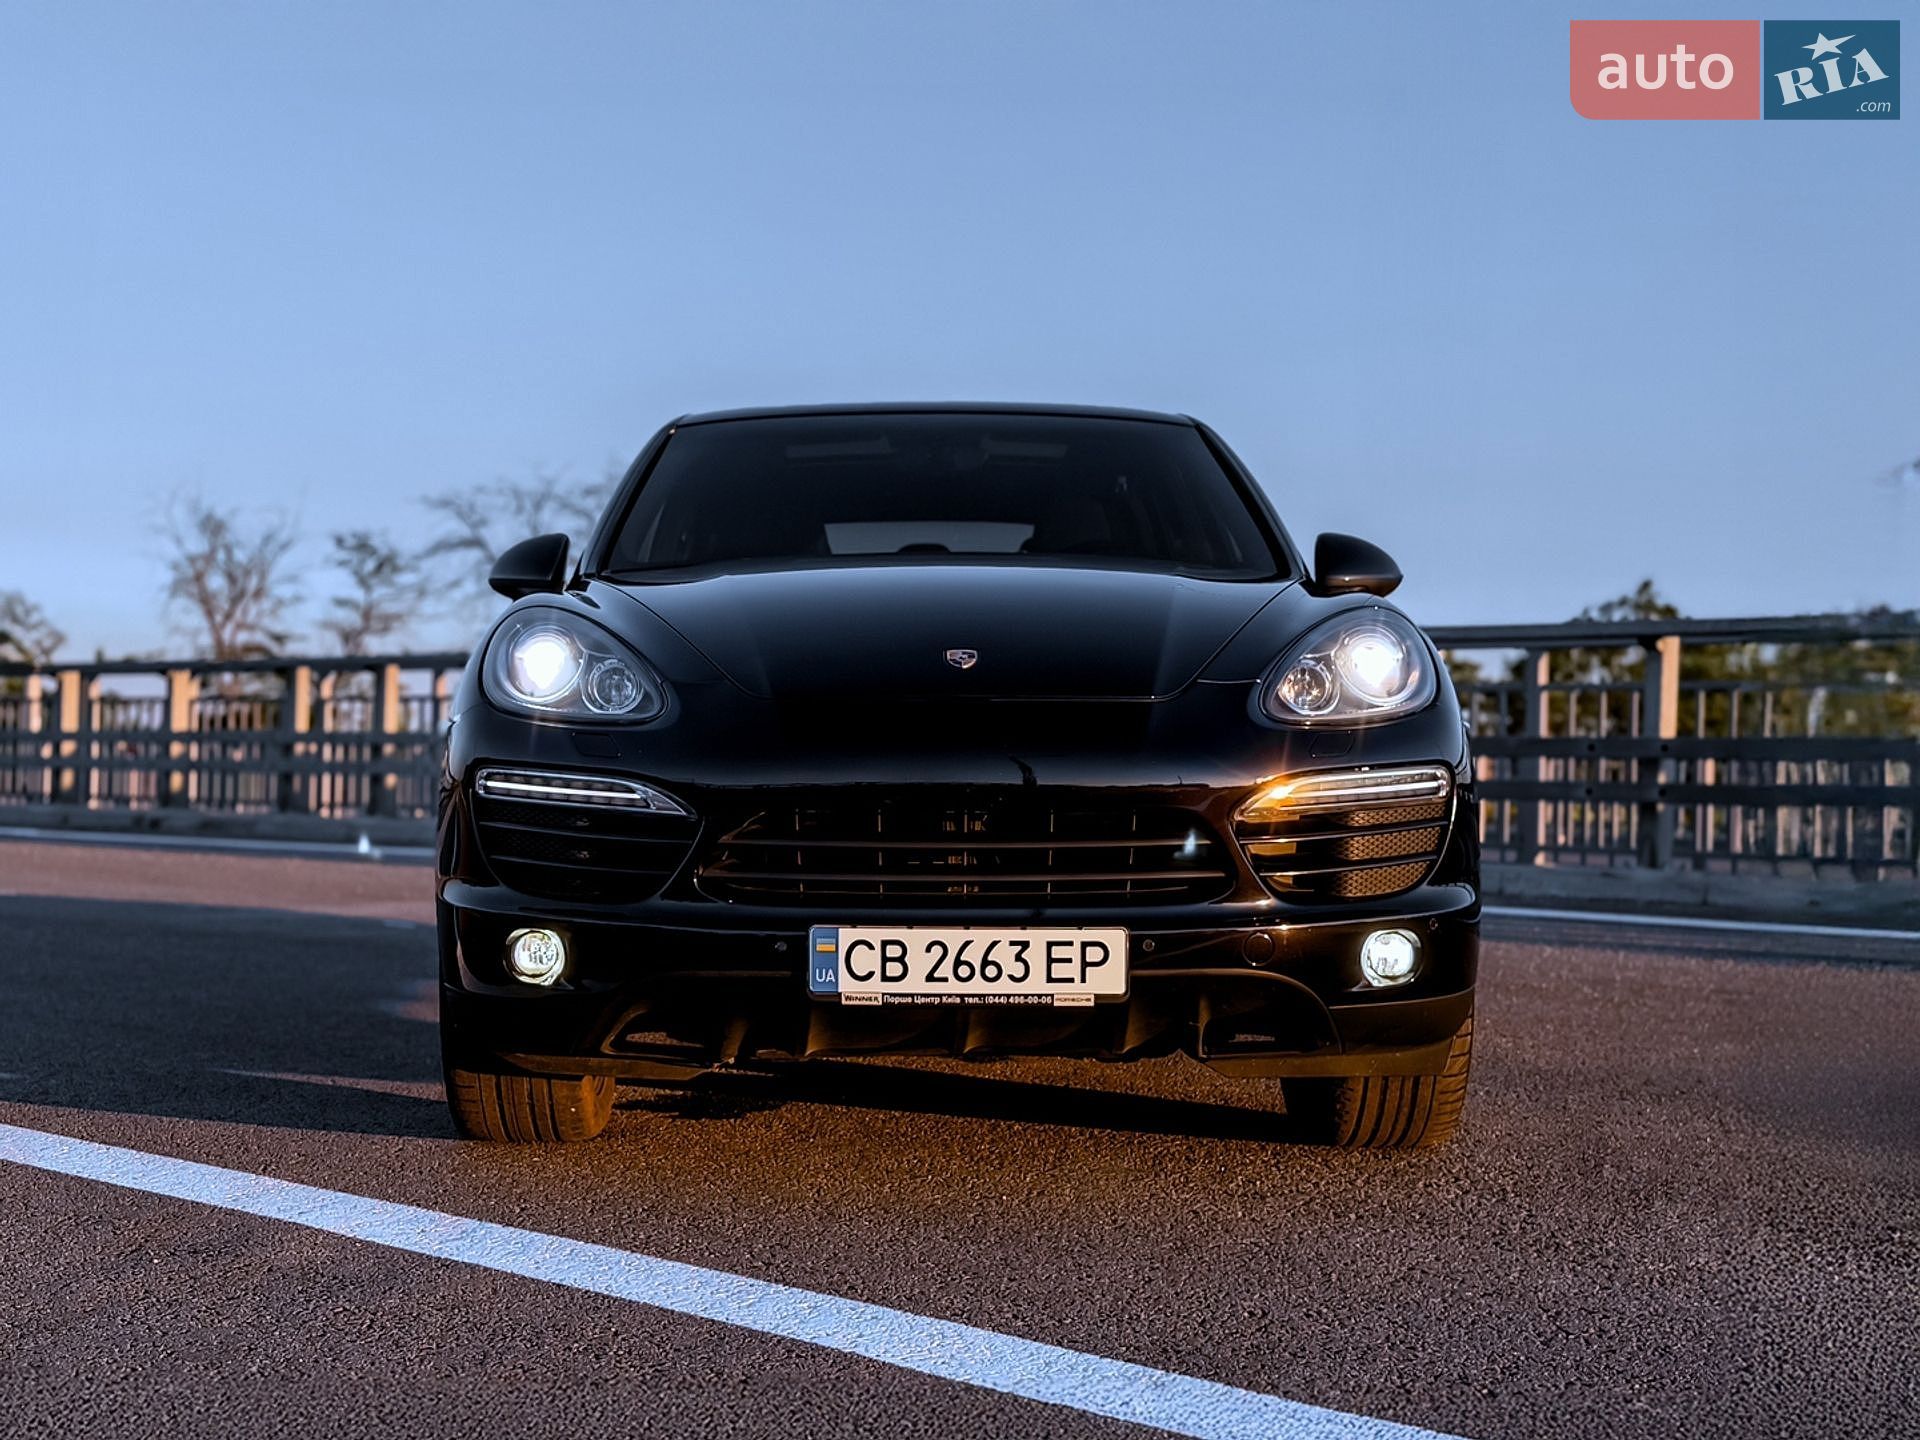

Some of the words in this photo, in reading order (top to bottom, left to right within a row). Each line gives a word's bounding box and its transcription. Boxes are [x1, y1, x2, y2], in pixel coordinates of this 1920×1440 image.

[844, 938, 909, 983] CB
[924, 938, 1031, 984] 2663
[1045, 940, 1110, 984] EP
[815, 968, 836, 983] UA
[883, 994, 912, 1005] Порше
[914, 994, 941, 1005] Центр
[985, 995, 1008, 1004] (044)
